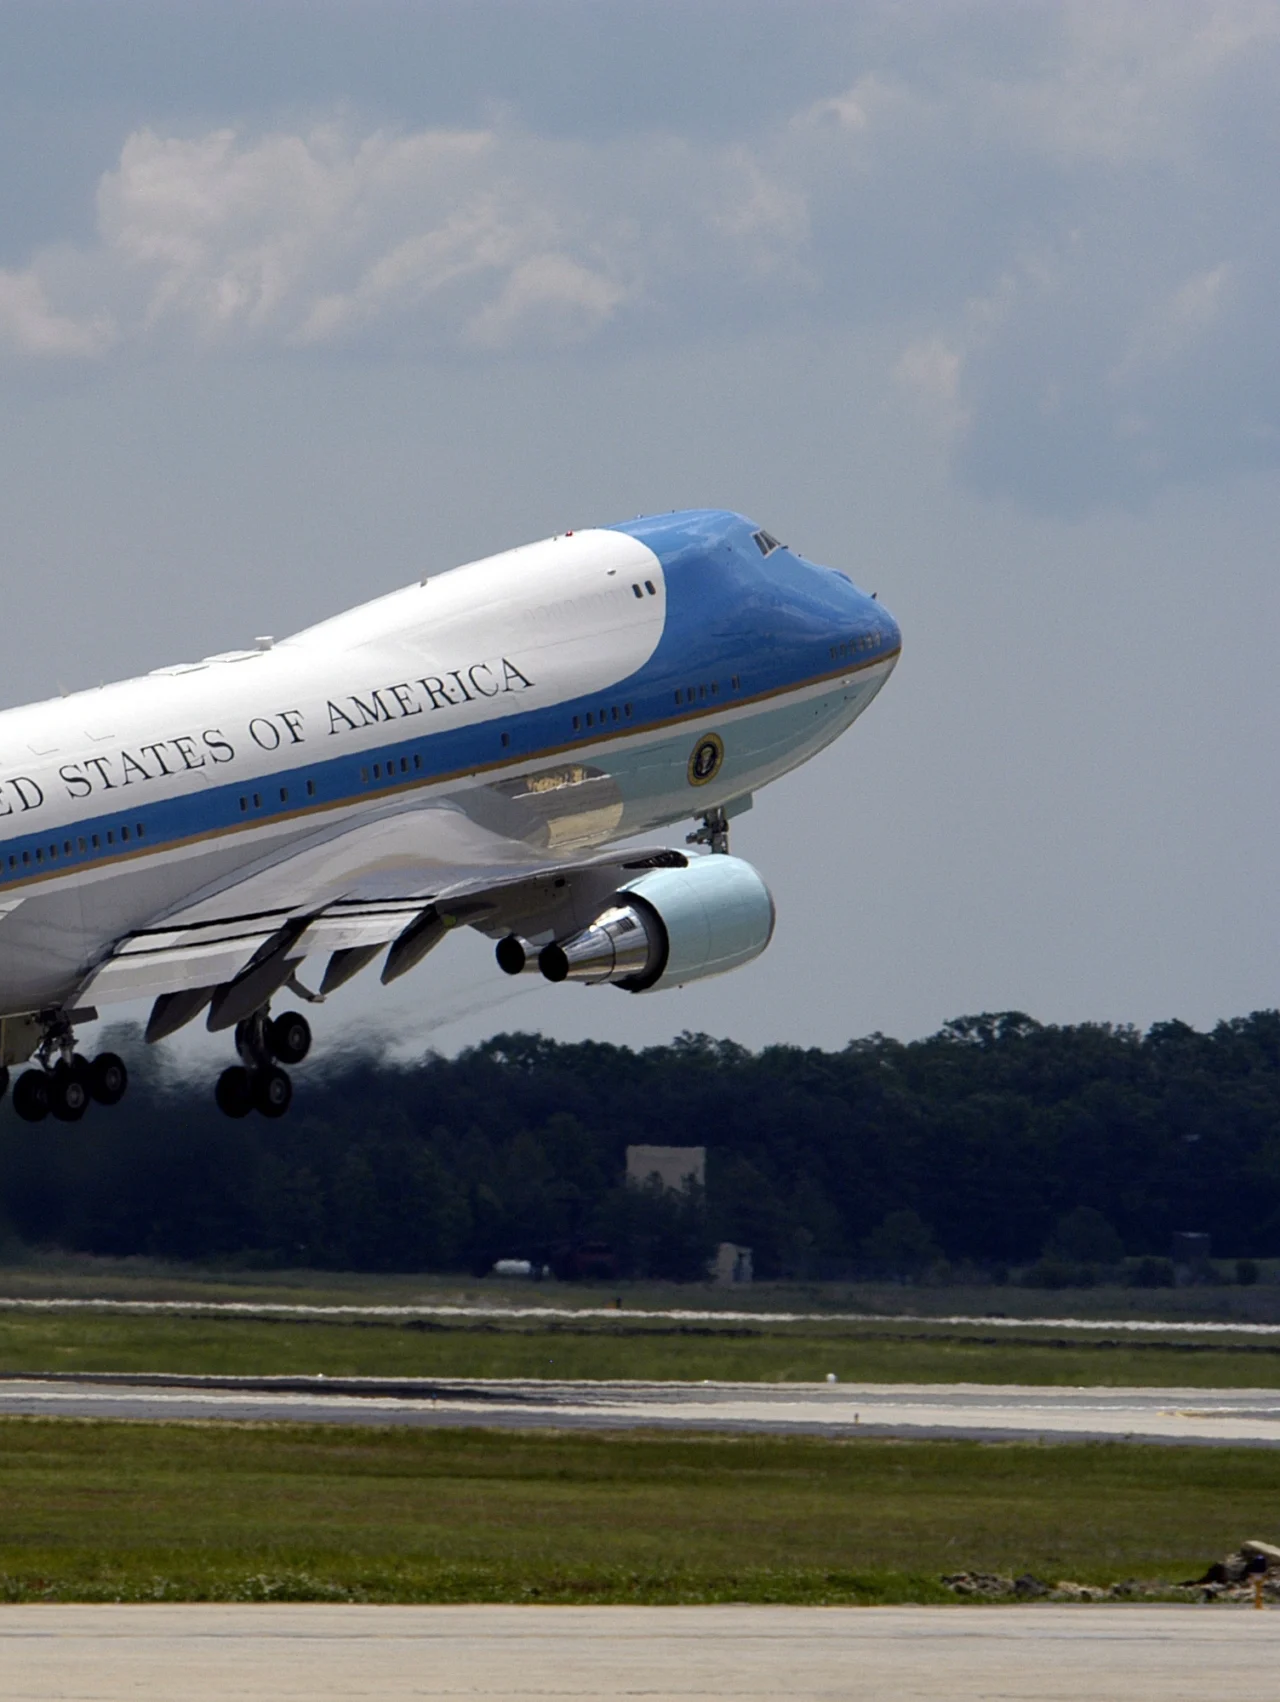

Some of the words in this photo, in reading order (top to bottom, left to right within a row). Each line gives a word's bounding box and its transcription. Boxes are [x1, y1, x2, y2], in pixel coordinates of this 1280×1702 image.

[59, 729, 235, 800] STATES
[248, 709, 306, 752] OF
[326, 657, 535, 736] AMERICA
